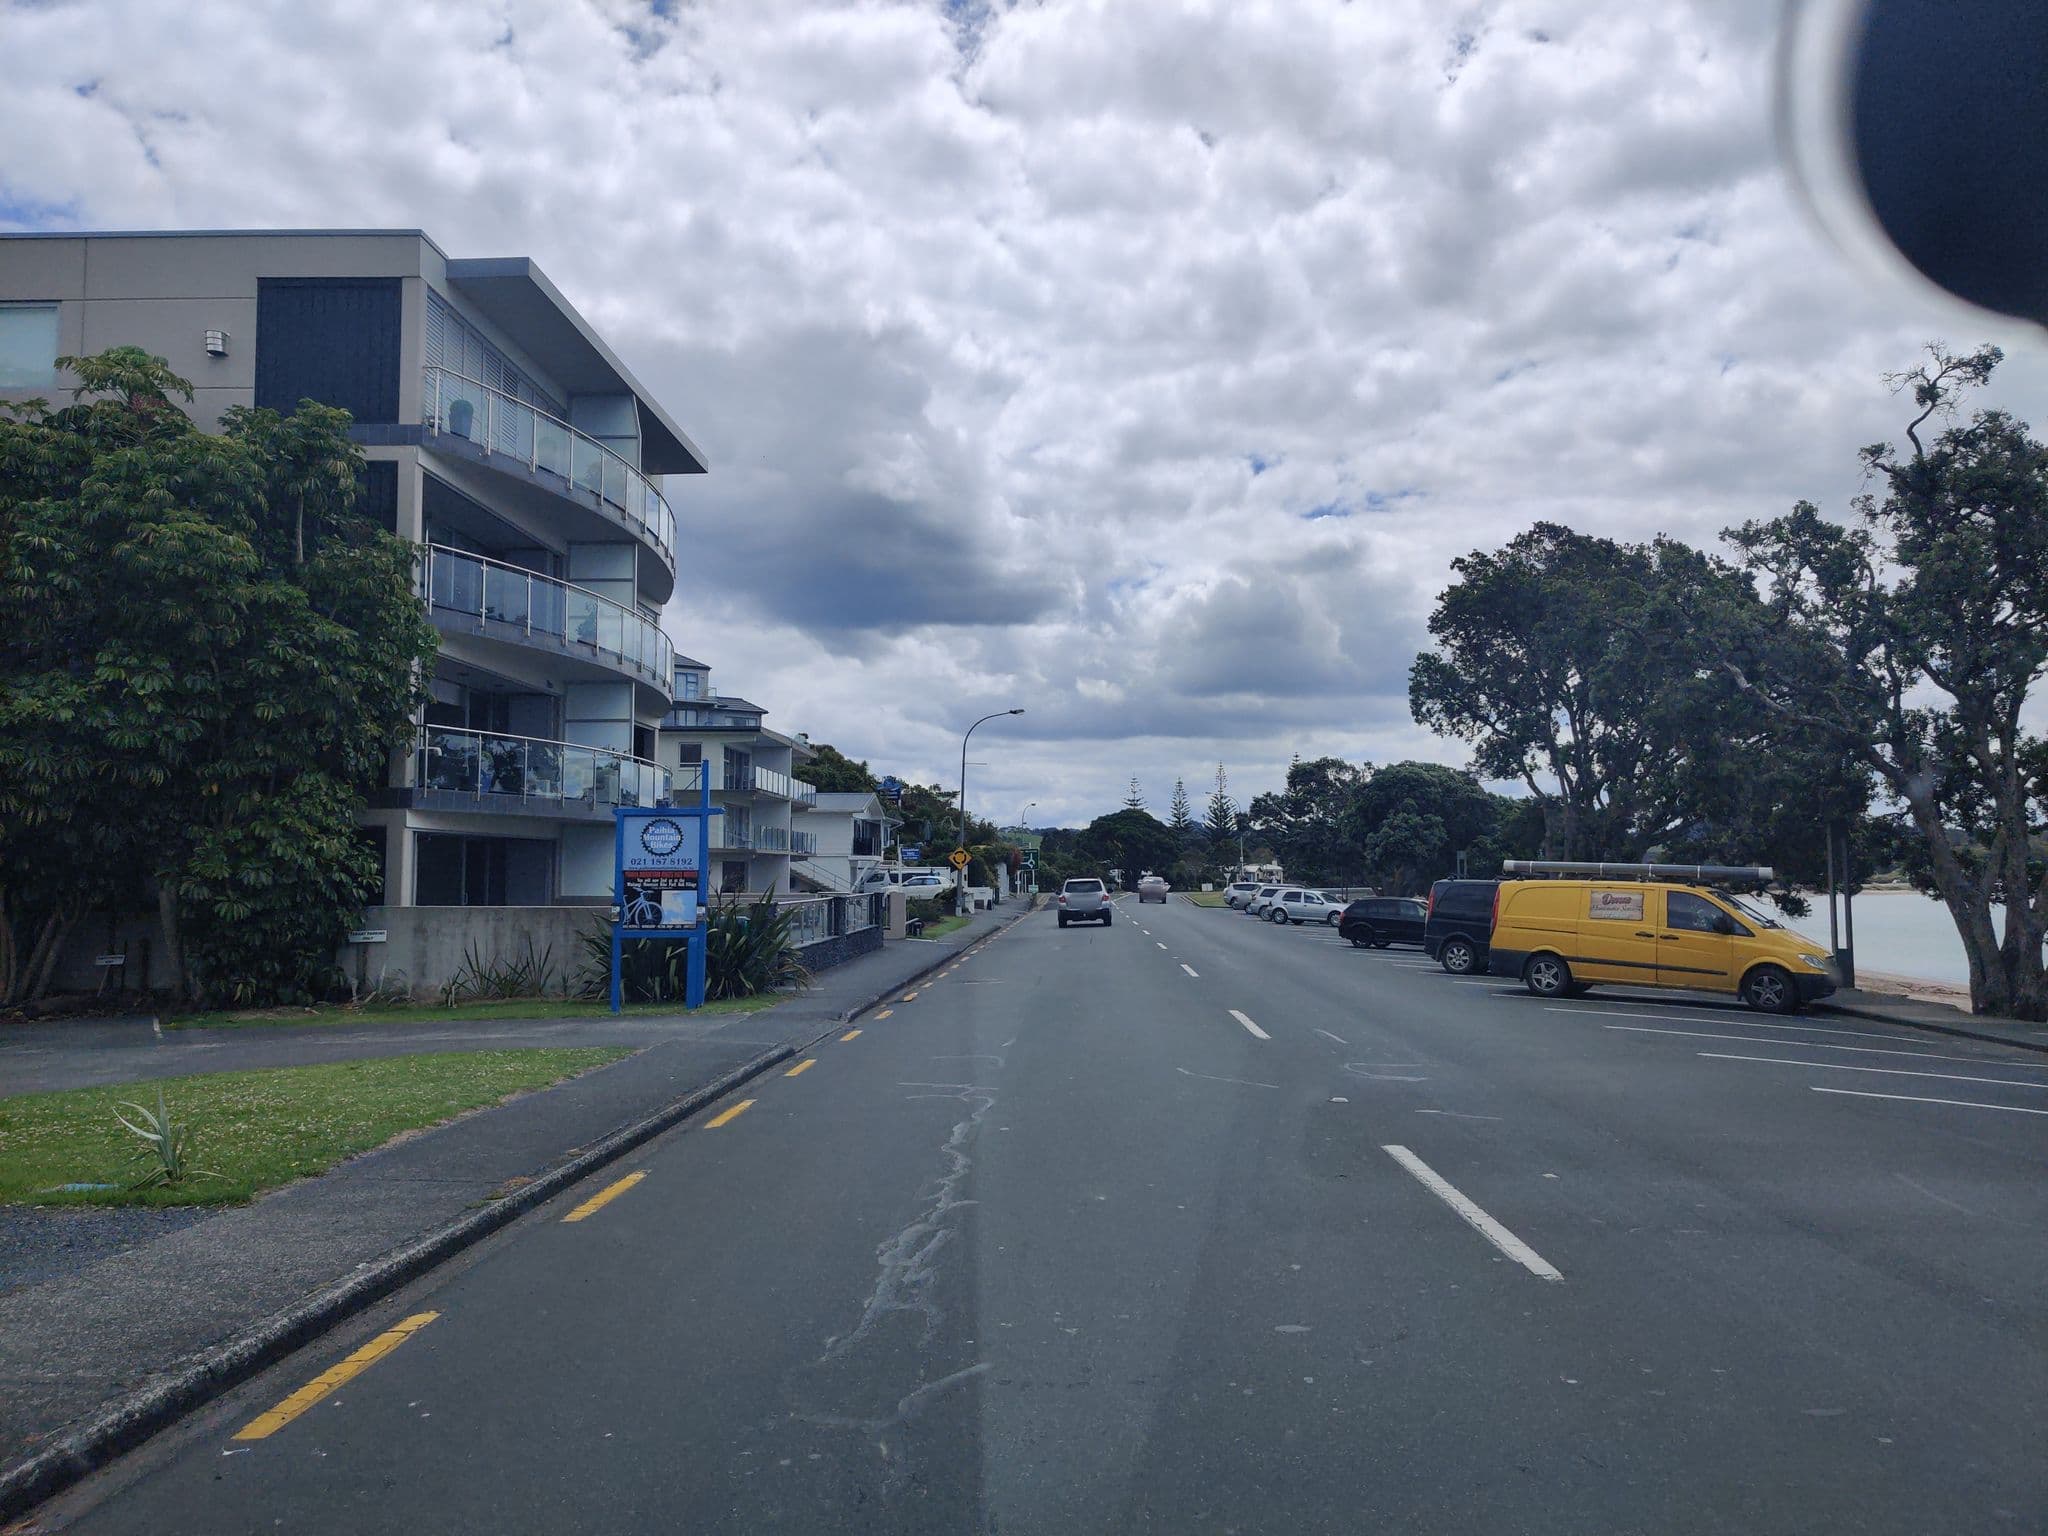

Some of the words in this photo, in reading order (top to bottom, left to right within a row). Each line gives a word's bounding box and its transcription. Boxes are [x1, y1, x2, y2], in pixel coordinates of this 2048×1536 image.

[648, 826, 675, 834] Paihia
[643, 833, 681, 841] Mountain
[650, 841, 673, 849] Bikes
[630, 858, 647, 866] 021
[651, 858, 667, 866] 187
[670, 858, 693, 866] 8192
